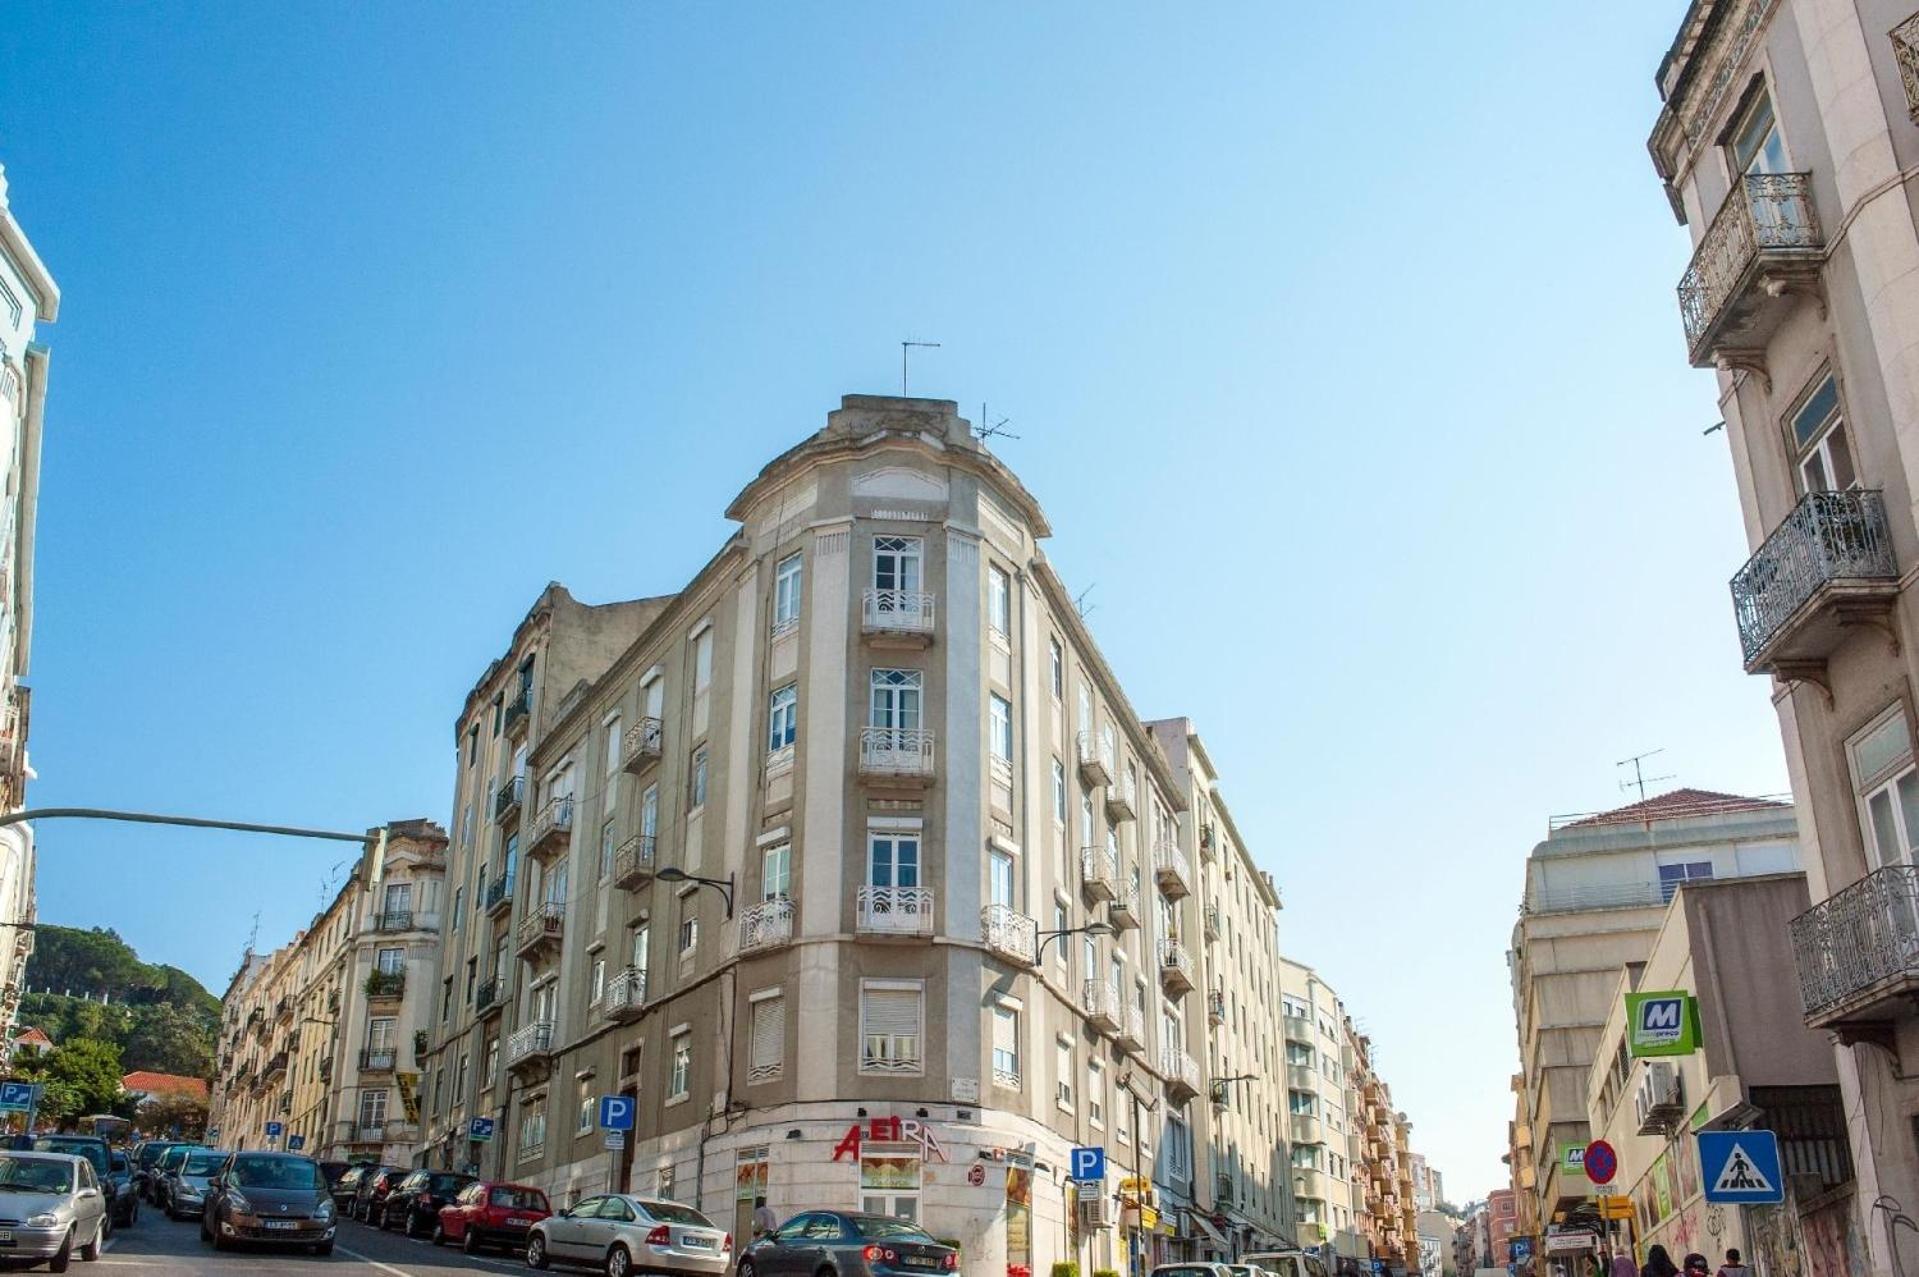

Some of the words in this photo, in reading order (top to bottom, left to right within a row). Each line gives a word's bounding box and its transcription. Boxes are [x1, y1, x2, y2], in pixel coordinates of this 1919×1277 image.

[1646, 1002, 1677, 1027] M
[5, 1086, 17, 1098] P
[607, 1099, 627, 1126] P
[269, 1123, 279, 1134] P
[473, 1120, 483, 1131] P
[1569, 1149, 1584, 1161] M
[1078, 1151, 1098, 1178] P
[1515, 1243, 1525, 1256] P
